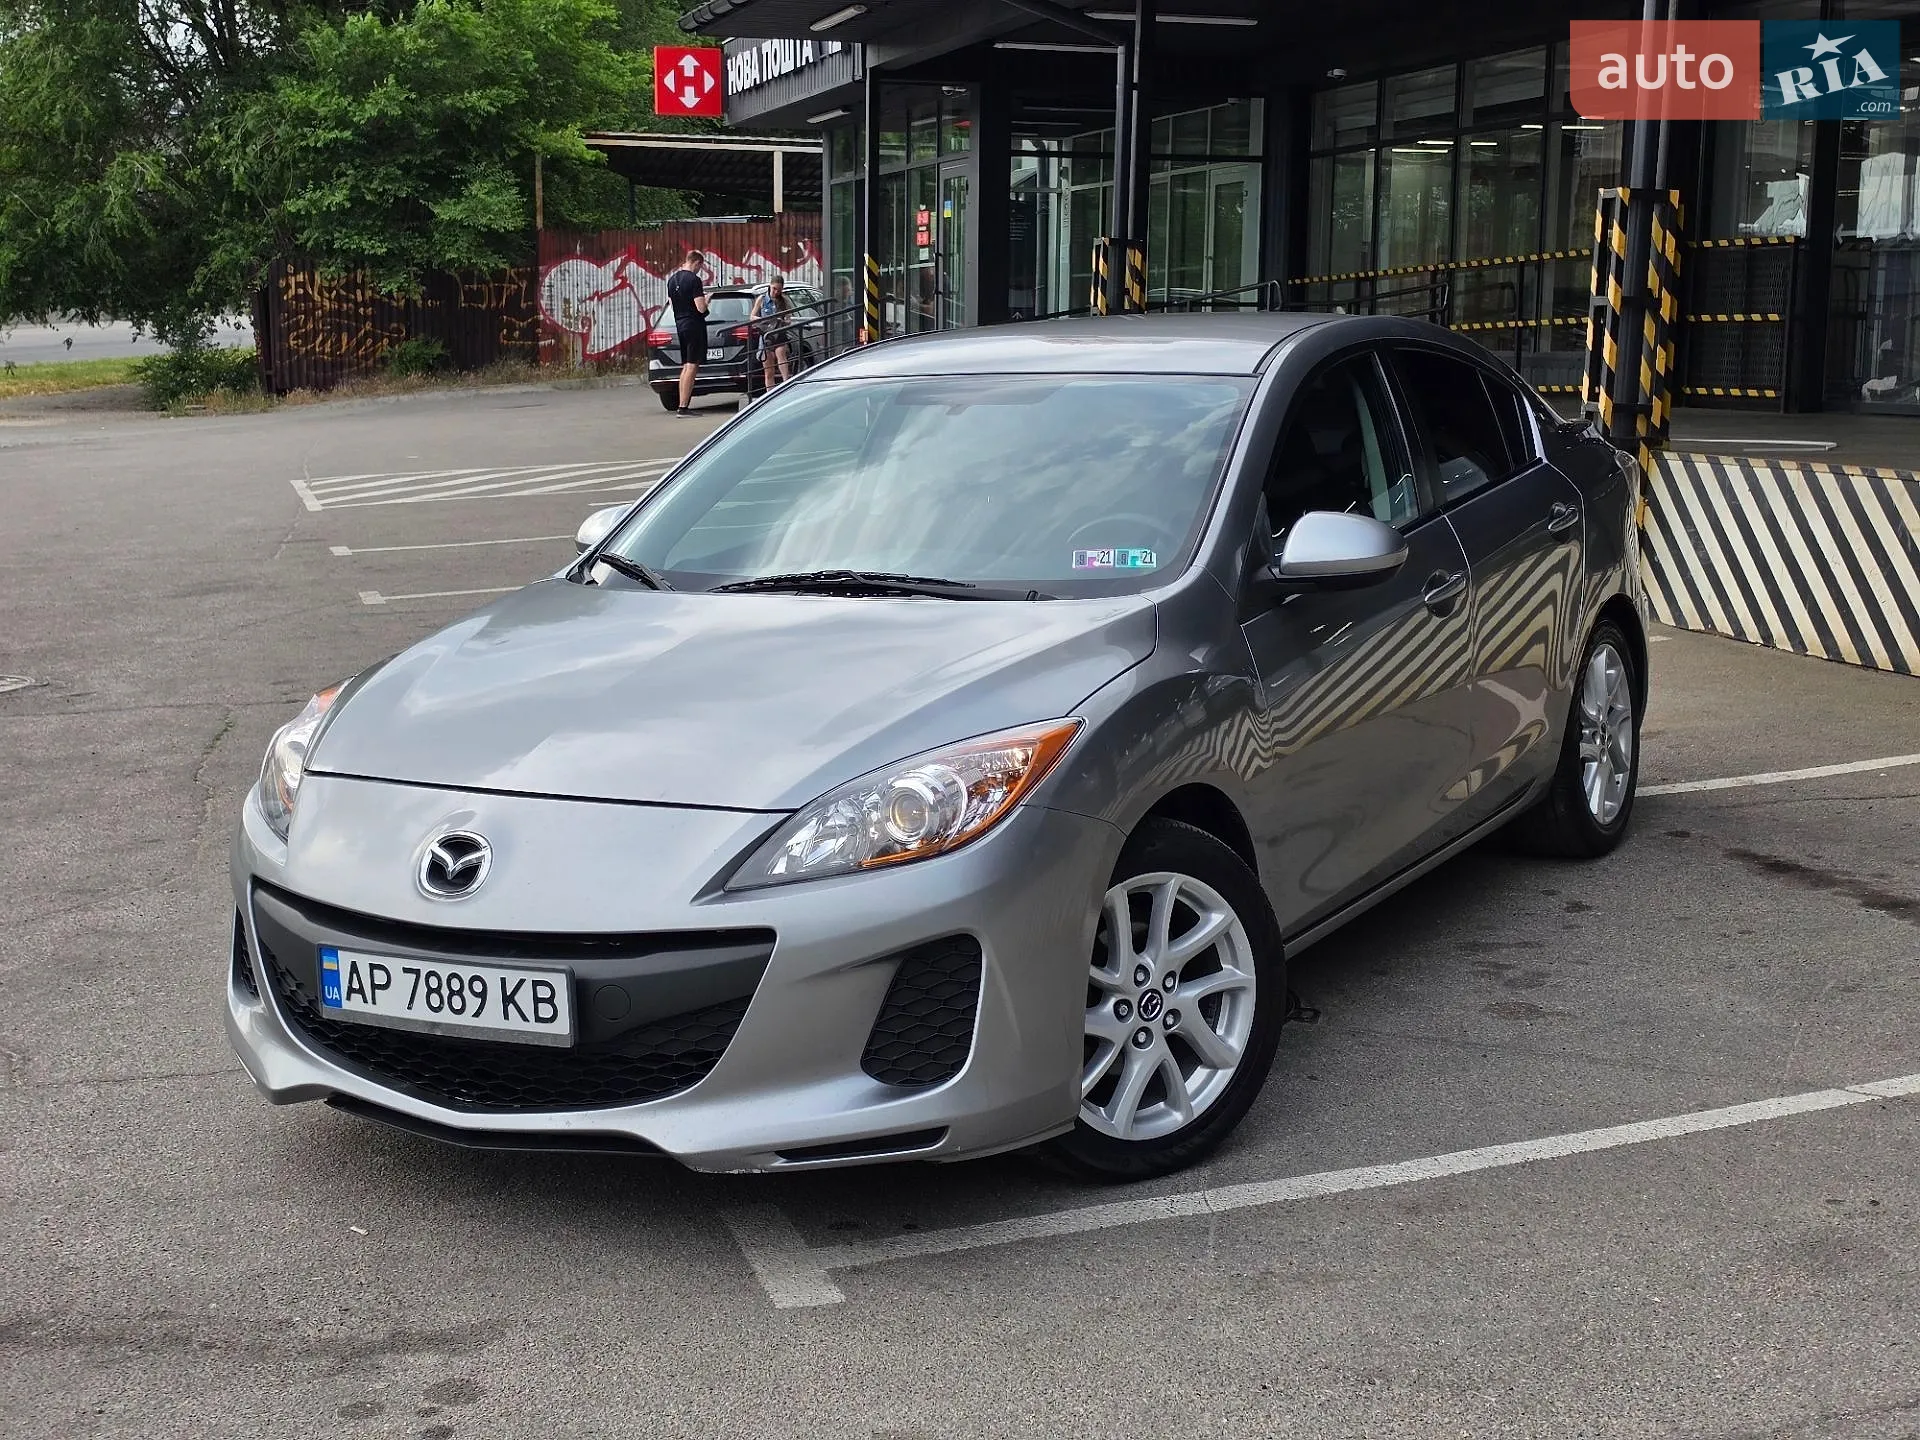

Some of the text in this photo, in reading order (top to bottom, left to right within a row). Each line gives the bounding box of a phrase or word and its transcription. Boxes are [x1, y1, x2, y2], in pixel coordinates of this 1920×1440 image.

[727, 38, 814, 96] НОВА ПОШТА
[1099, 550, 1111, 564] 21
[1142, 550, 1154, 564] 21
[324, 985, 340, 1001] UA
[345, 960, 559, 1024] AP 7889 KB
